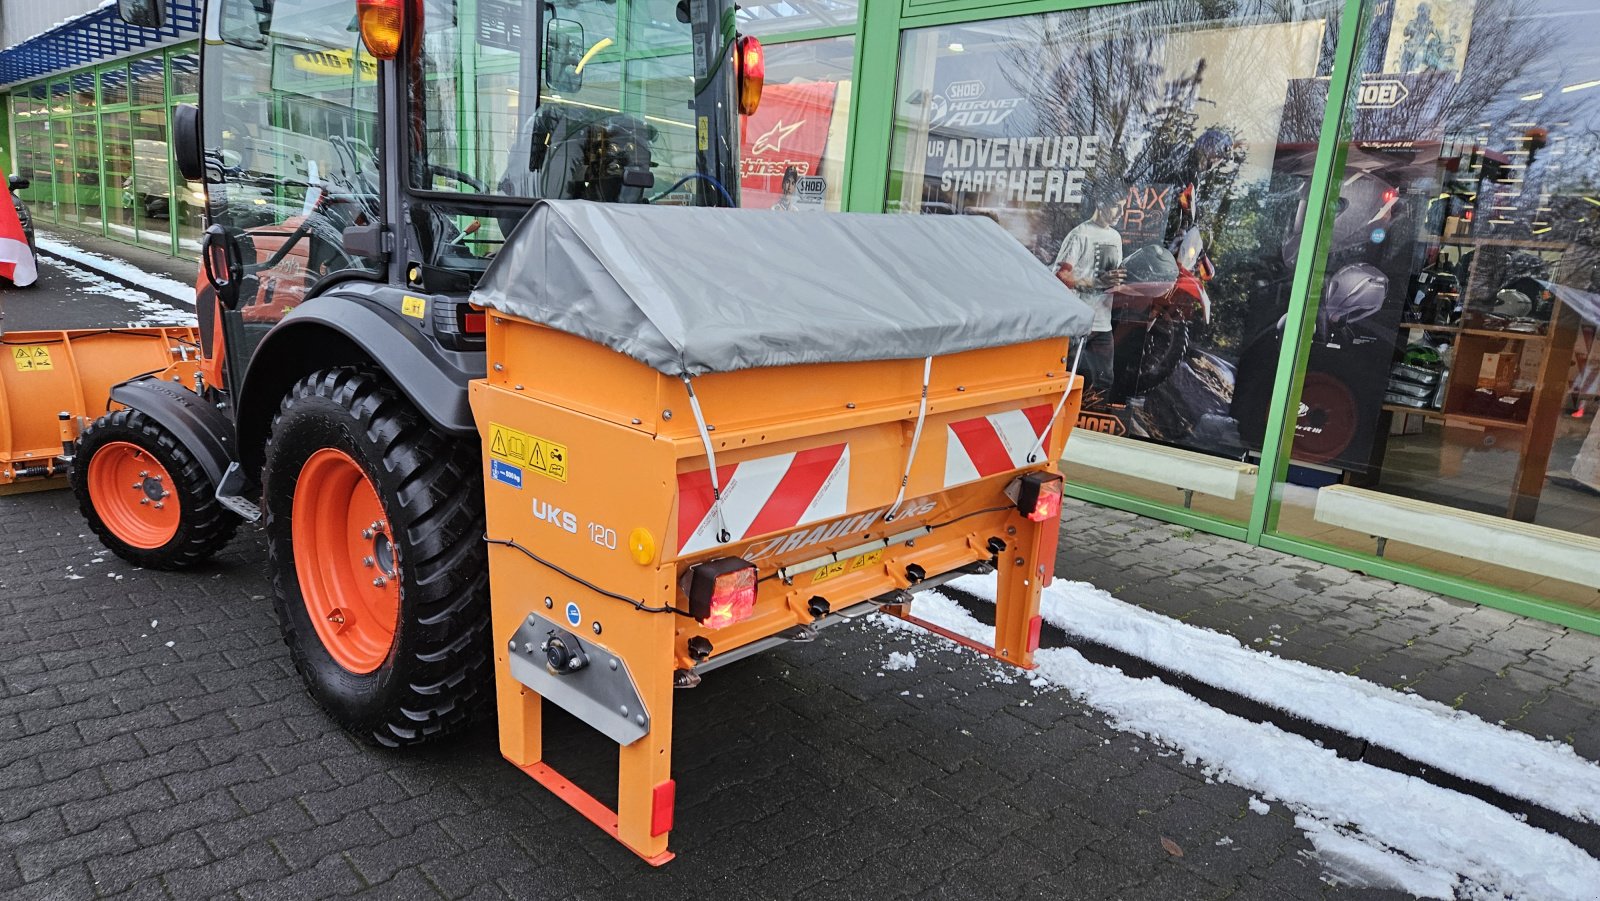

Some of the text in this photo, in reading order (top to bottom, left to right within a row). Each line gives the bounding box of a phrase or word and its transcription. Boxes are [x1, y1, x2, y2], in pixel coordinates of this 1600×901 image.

[951, 84, 980, 98] SHOEI
[948, 97, 1025, 111] HORNET
[944, 109, 1014, 127] ADV
[943, 135, 1100, 168] ADVENTURE
[800, 180, 823, 192] SHOEI
[941, 170, 1086, 204] STARTS HERE
[1126, 186, 1170, 210] NX
[532, 498, 617, 550] UKS 120
[775, 510, 883, 556] RAUCH
